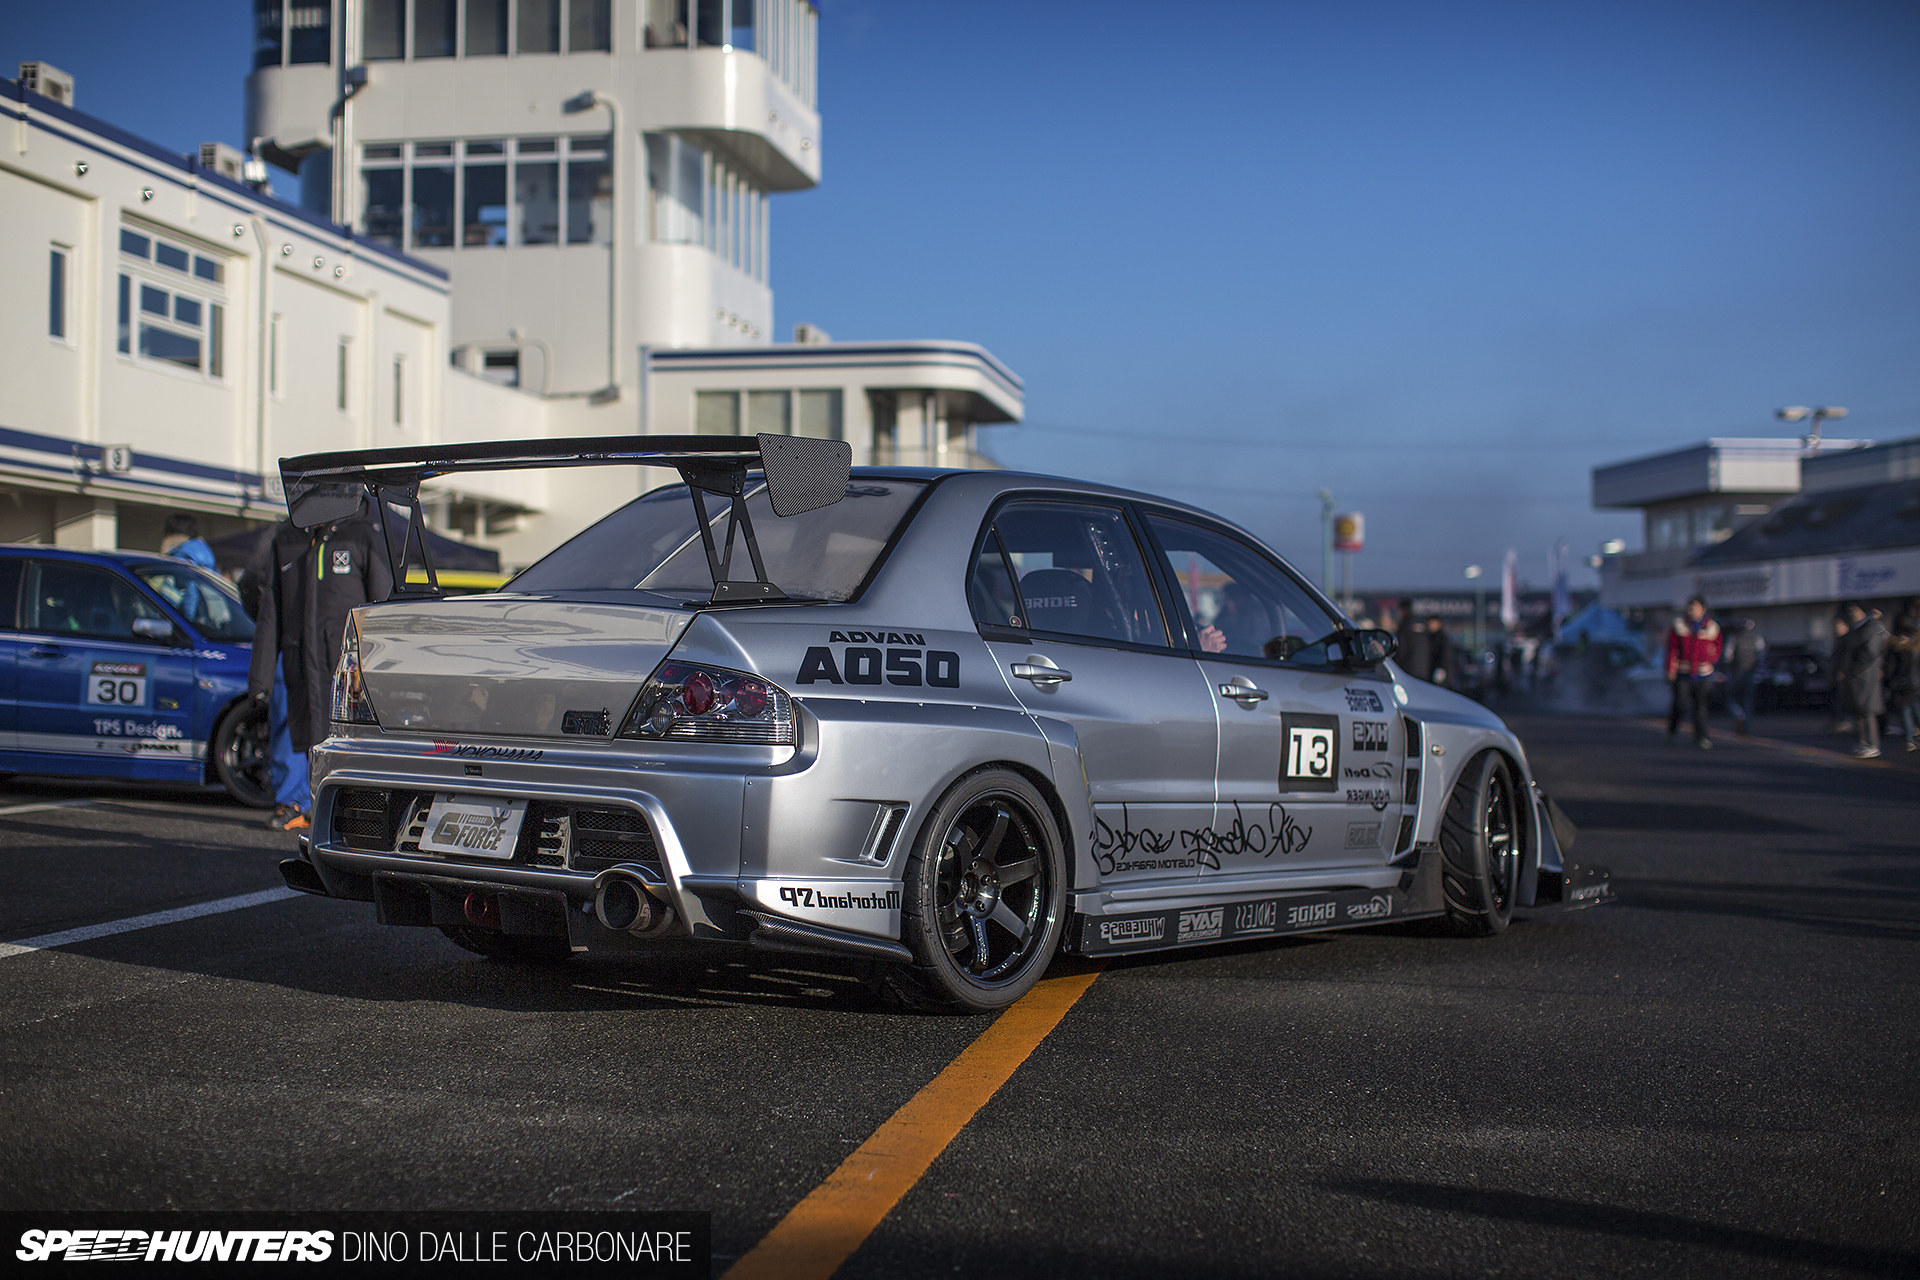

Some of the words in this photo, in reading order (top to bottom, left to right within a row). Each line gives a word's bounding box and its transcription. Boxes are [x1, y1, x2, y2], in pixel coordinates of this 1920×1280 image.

[829, 631, 926, 646] ADVAN
[795, 646, 960, 688] A050
[97, 680, 138, 703] 30
[93, 719, 121, 735] TPS
[452, 744, 544, 762] YOKOHAMA
[1293, 734, 1329, 776] 13
[468, 815, 488, 824] GARAGE
